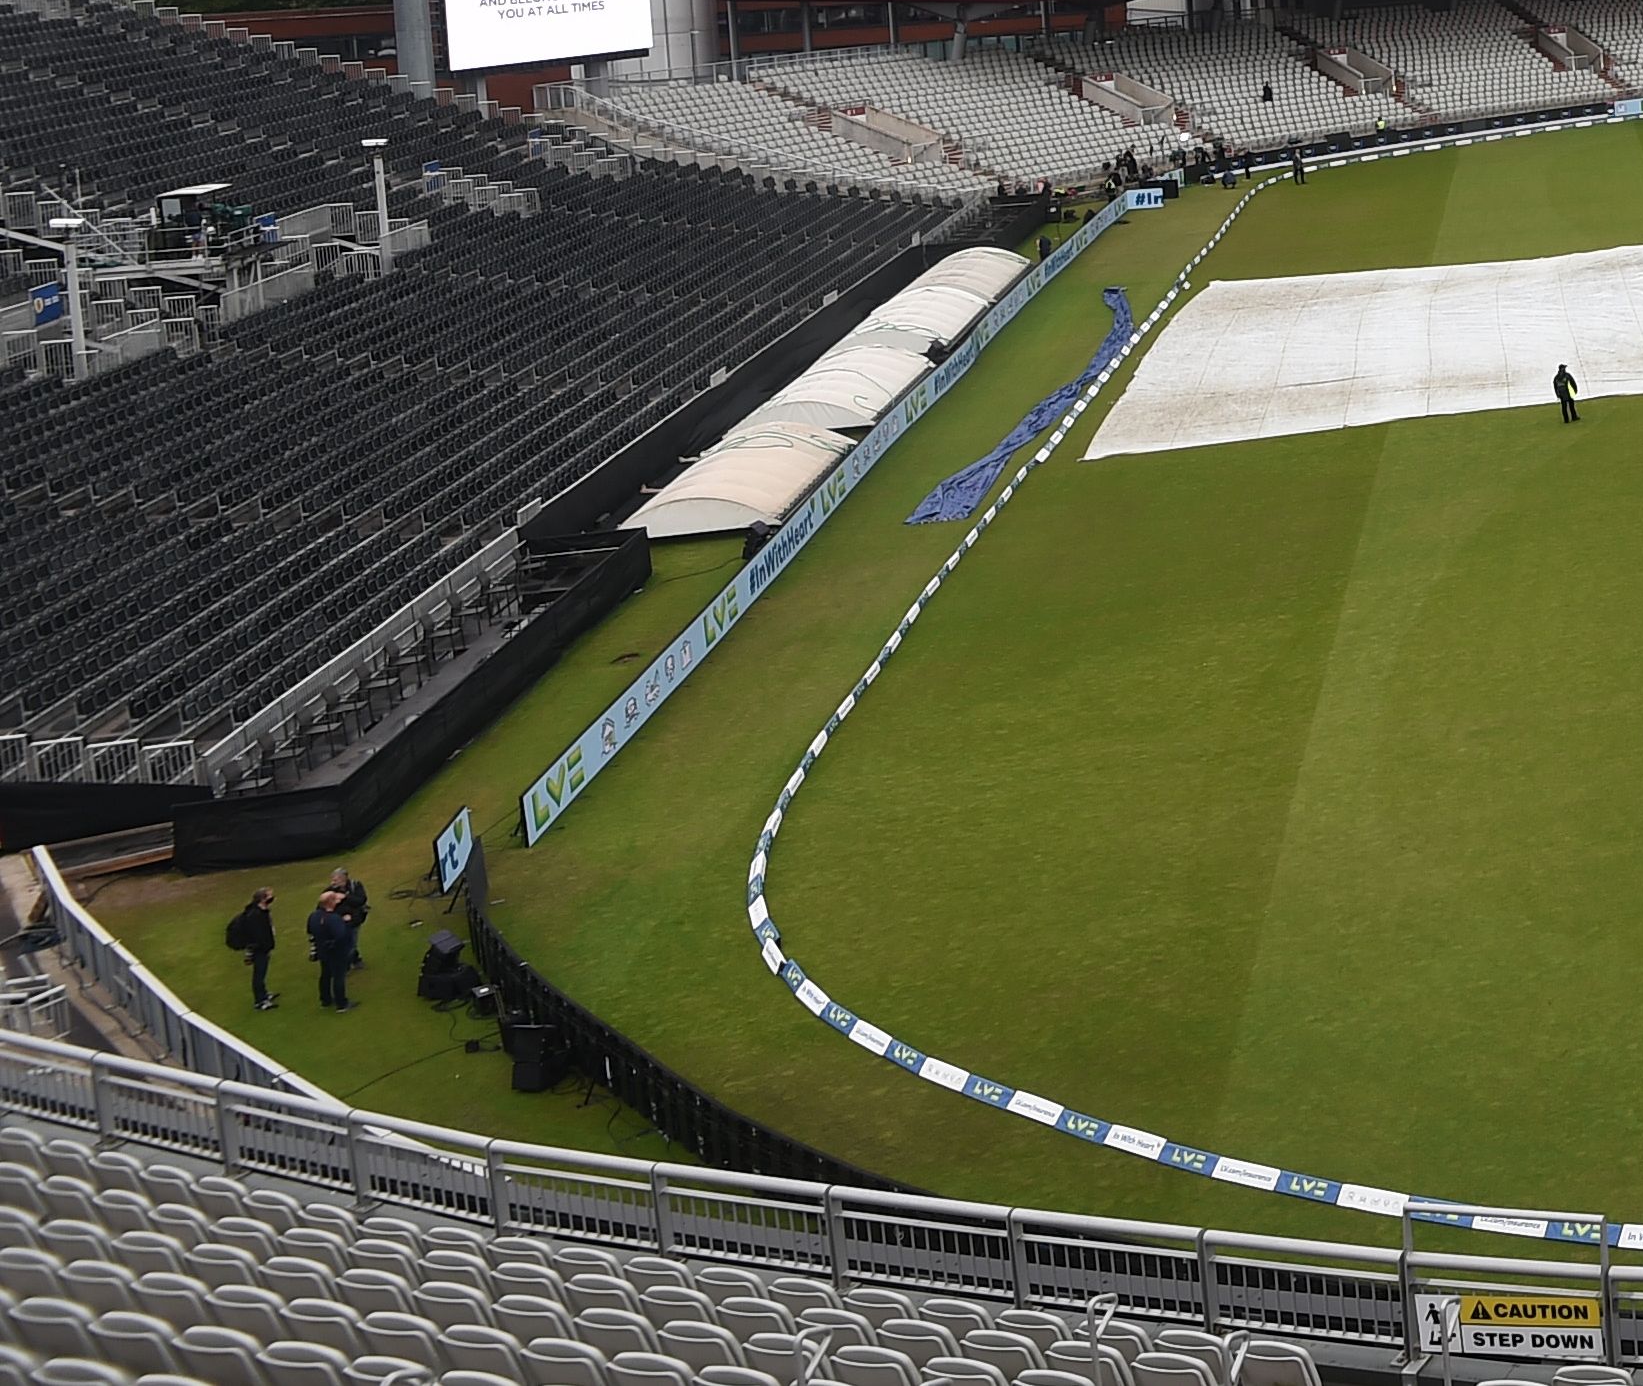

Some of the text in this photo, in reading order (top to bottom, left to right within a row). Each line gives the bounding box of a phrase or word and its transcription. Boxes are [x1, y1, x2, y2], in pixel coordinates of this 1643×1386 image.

[498, 1, 605, 19] YOU AT ALL TIMES
[748, 510, 814, 597] #InWithHeart
[1628, 1232, 1636, 1242] In
[1494, 1304, 1588, 1320] CAUTION
[1473, 1332, 1594, 1349] STEP DOWN
